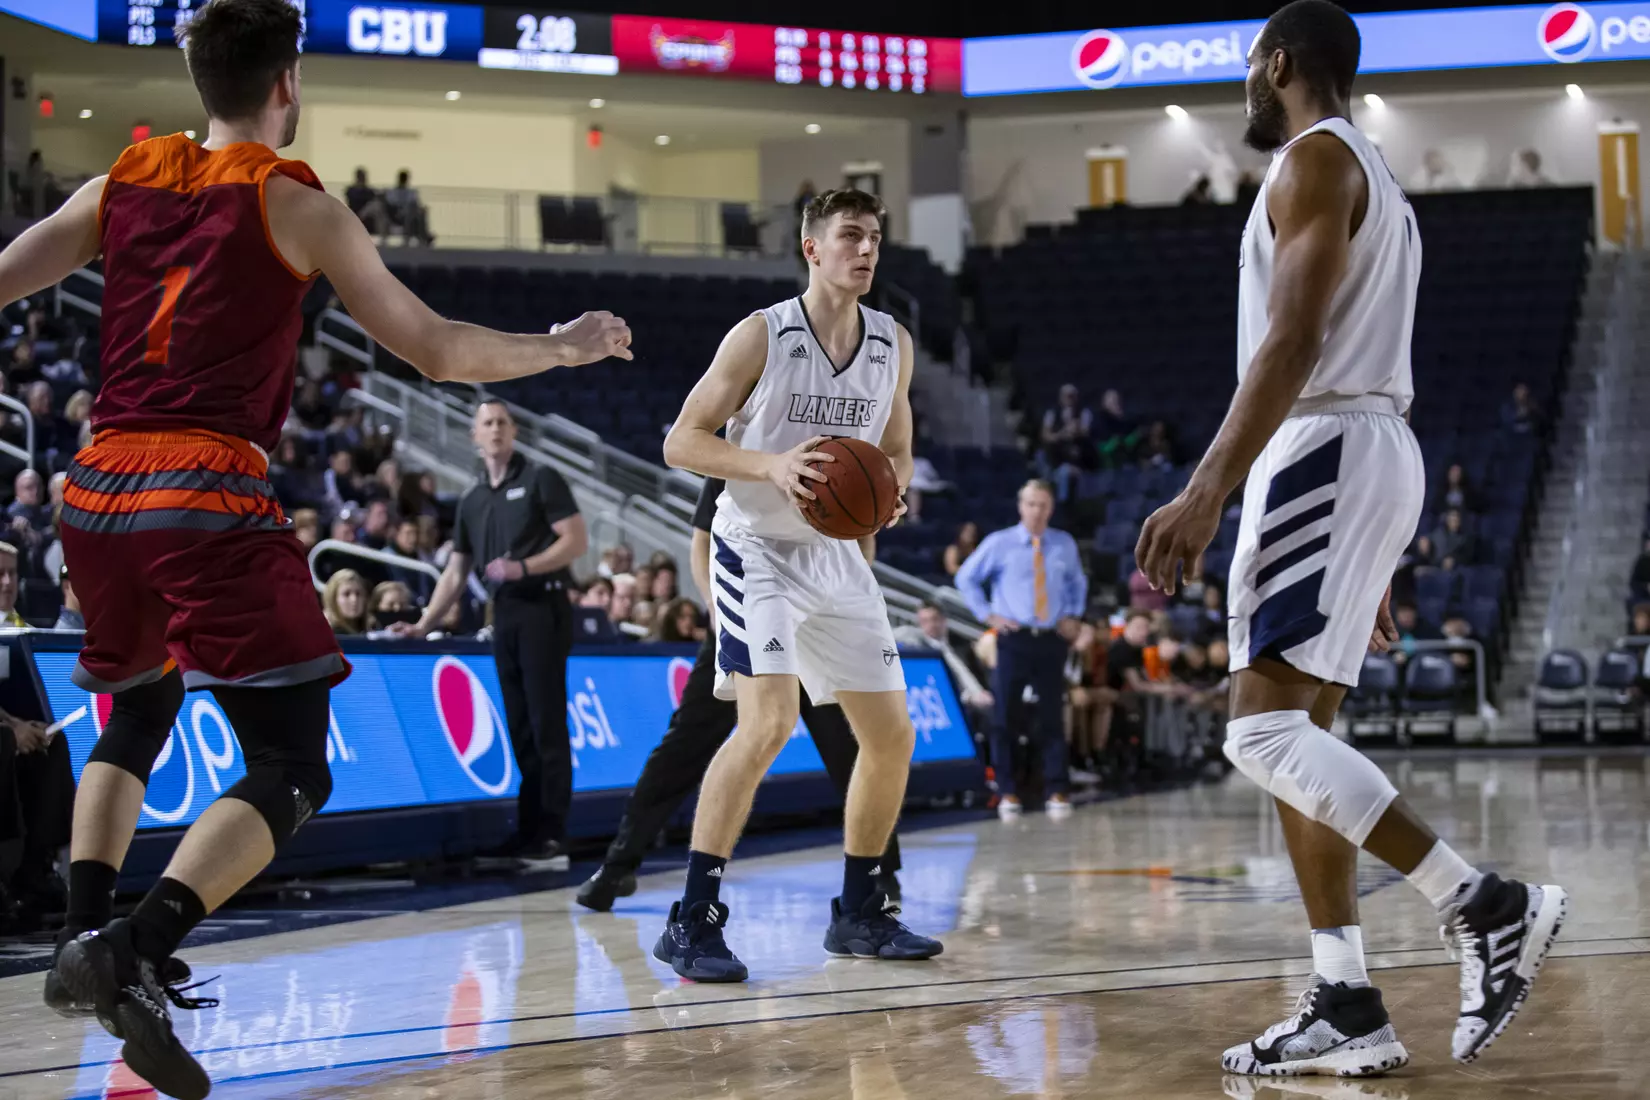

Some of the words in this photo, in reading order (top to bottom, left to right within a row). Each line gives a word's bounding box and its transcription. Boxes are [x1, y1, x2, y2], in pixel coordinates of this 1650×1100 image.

[347, 5, 447, 57] CBU
[1131, 29, 1242, 78] pepsi
[789, 352, 809, 360] adidas
[868, 355, 887, 365] WAC
[788, 394, 877, 427] LANCERS
[763, 644, 785, 653] adidas
